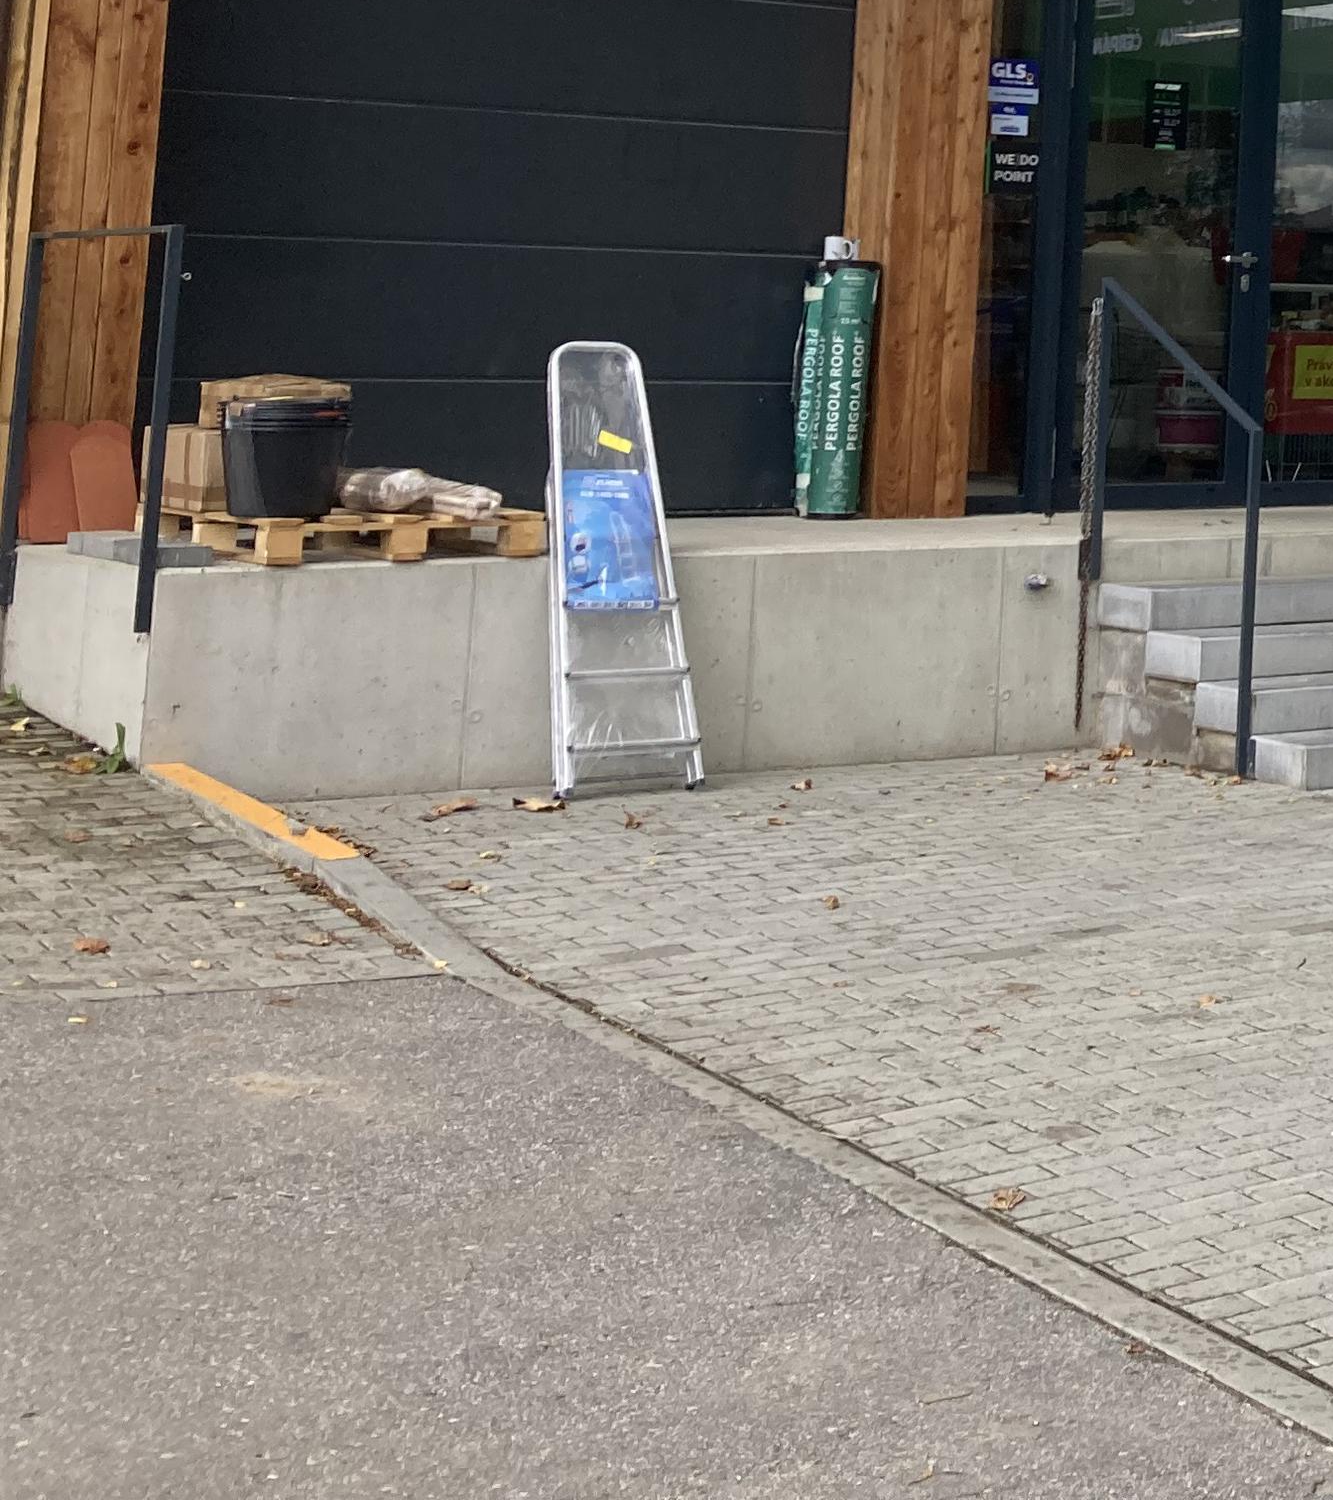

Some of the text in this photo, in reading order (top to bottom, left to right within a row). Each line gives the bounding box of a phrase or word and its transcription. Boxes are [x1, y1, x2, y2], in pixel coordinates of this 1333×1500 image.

[991, 61, 1028, 80] GLS
[993, 170, 1035, 183] POINT
[995, 153, 1039, 166] WE DO
[801, 328, 819, 396] PERGOLA
[824, 380, 842, 451] PERGOLA
[845, 380, 862, 451] PERGOLA
